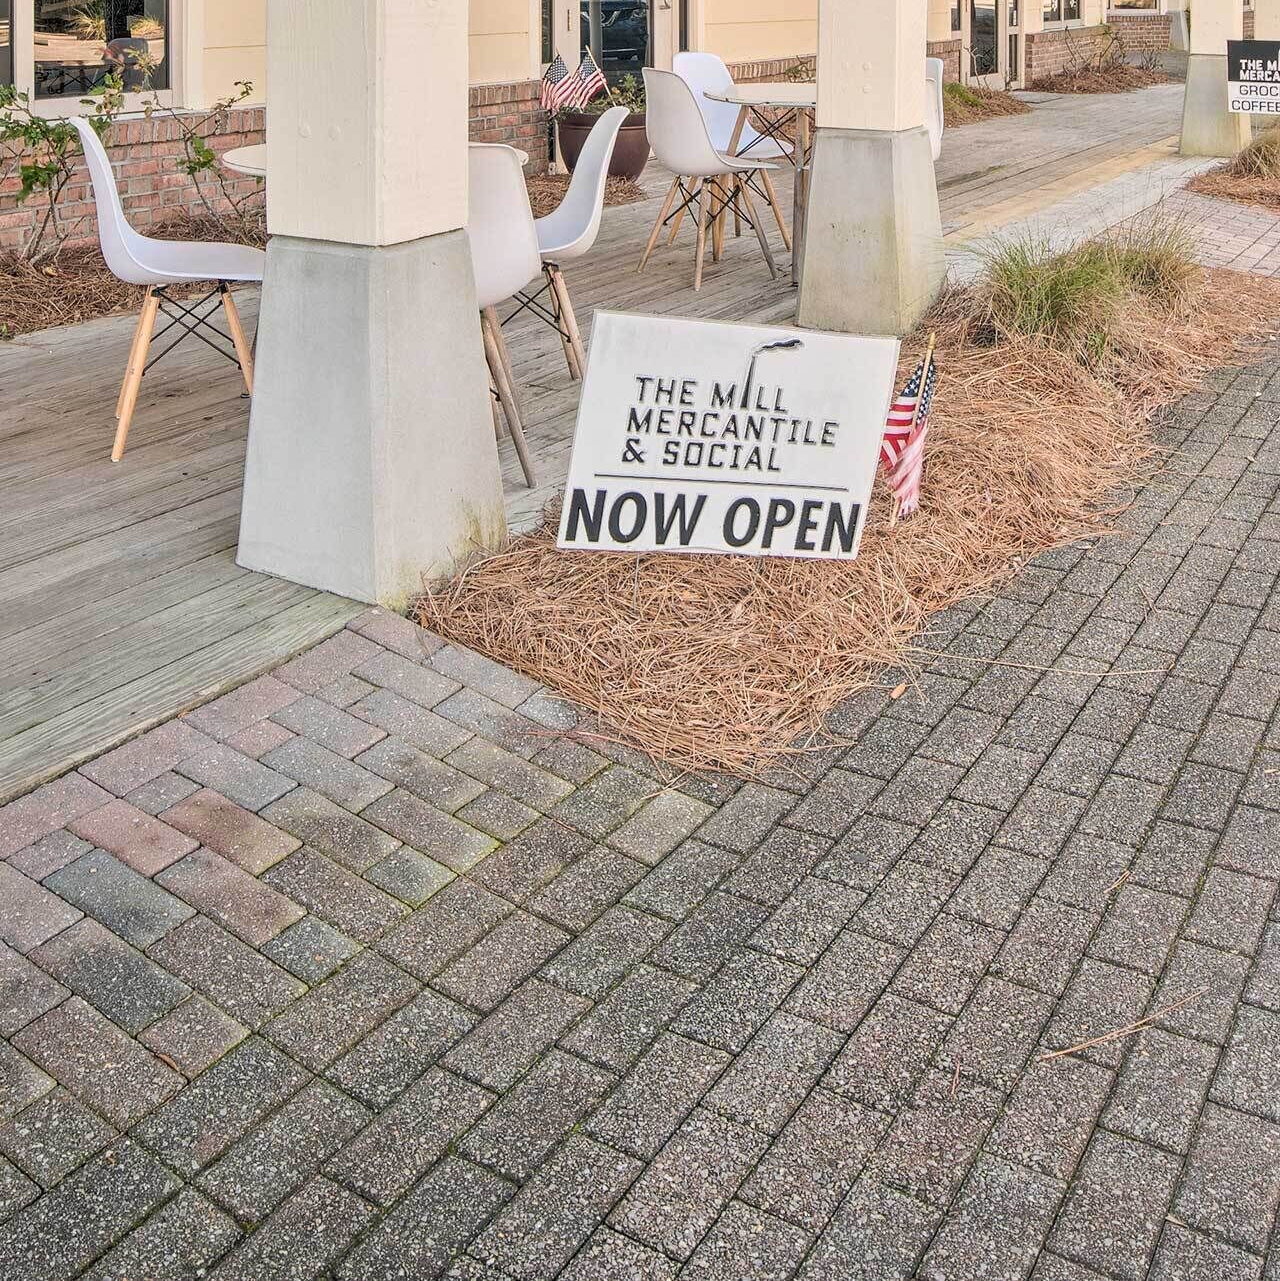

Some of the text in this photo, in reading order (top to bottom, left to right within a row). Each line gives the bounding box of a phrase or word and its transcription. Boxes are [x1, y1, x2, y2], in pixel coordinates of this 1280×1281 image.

[1240, 59, 1263, 71] THE
[635, 355, 788, 413] THE MILL
[626, 407, 840, 447] MERCANTILE
[621, 438, 782, 472] & SOCIAL
[565, 488, 861, 553] NOW OPEN
